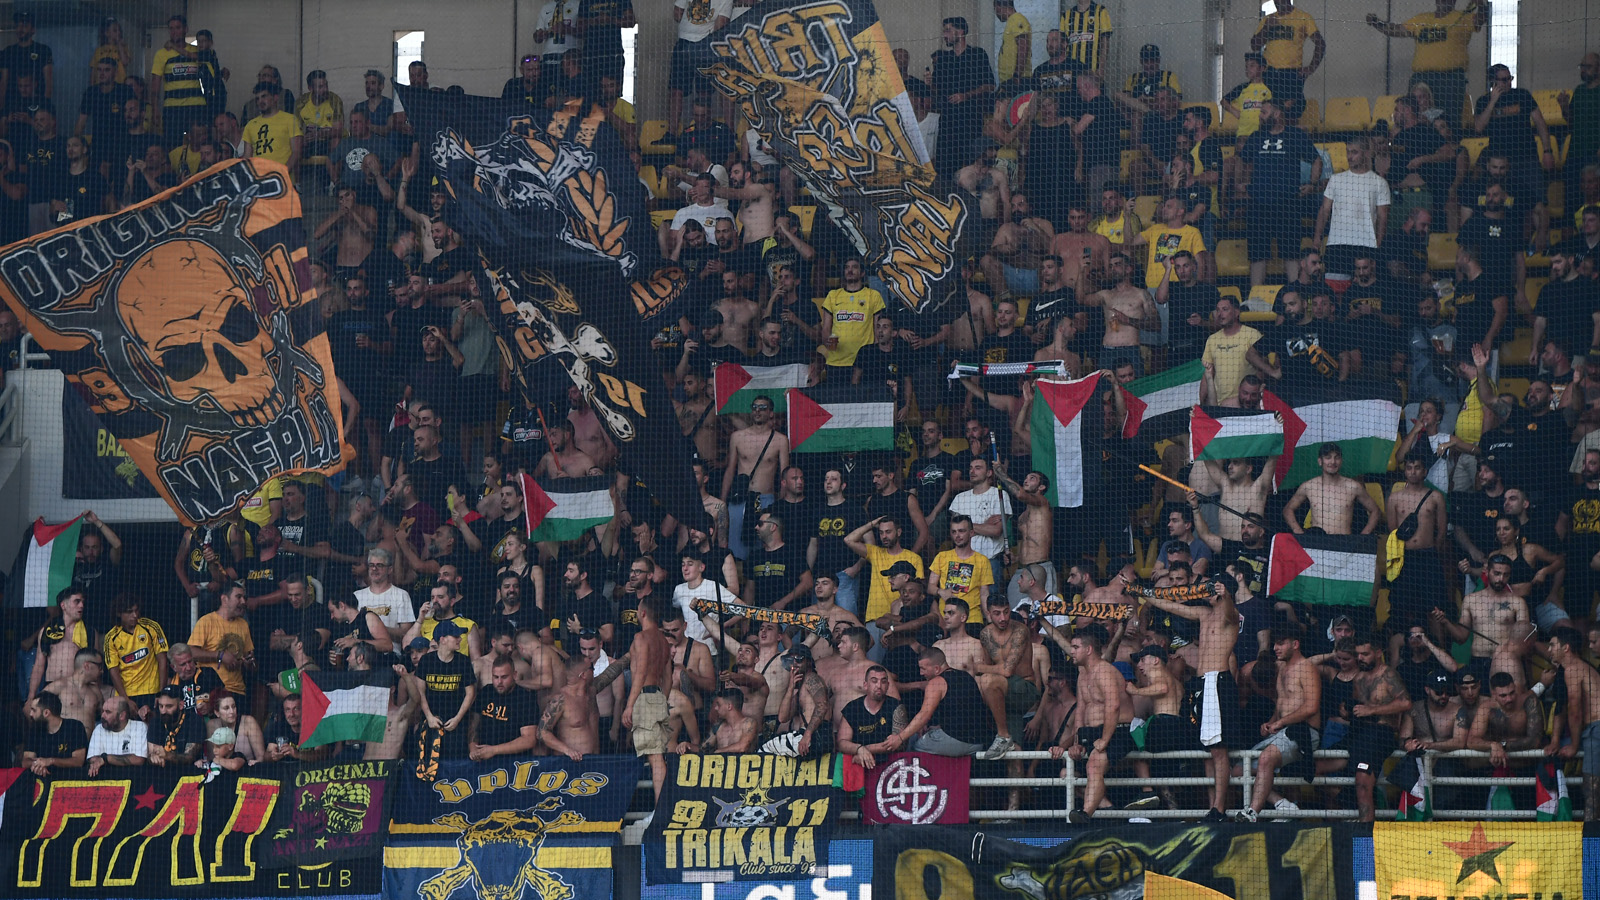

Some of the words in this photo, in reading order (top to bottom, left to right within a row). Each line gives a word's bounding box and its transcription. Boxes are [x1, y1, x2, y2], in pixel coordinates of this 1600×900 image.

[1, 160, 285, 312] ORIGINAL
[135, 649, 147, 660] TIM
[296, 762, 388, 787] ORIGINAL
[676, 753, 834, 789] ORIGINAL
[668, 799, 708, 828] 9
[662, 826, 817, 869] TRIKALA
[278, 869, 352, 889] CLUB
[739, 861, 767, 877] Club
[768, 862, 796, 875] since
